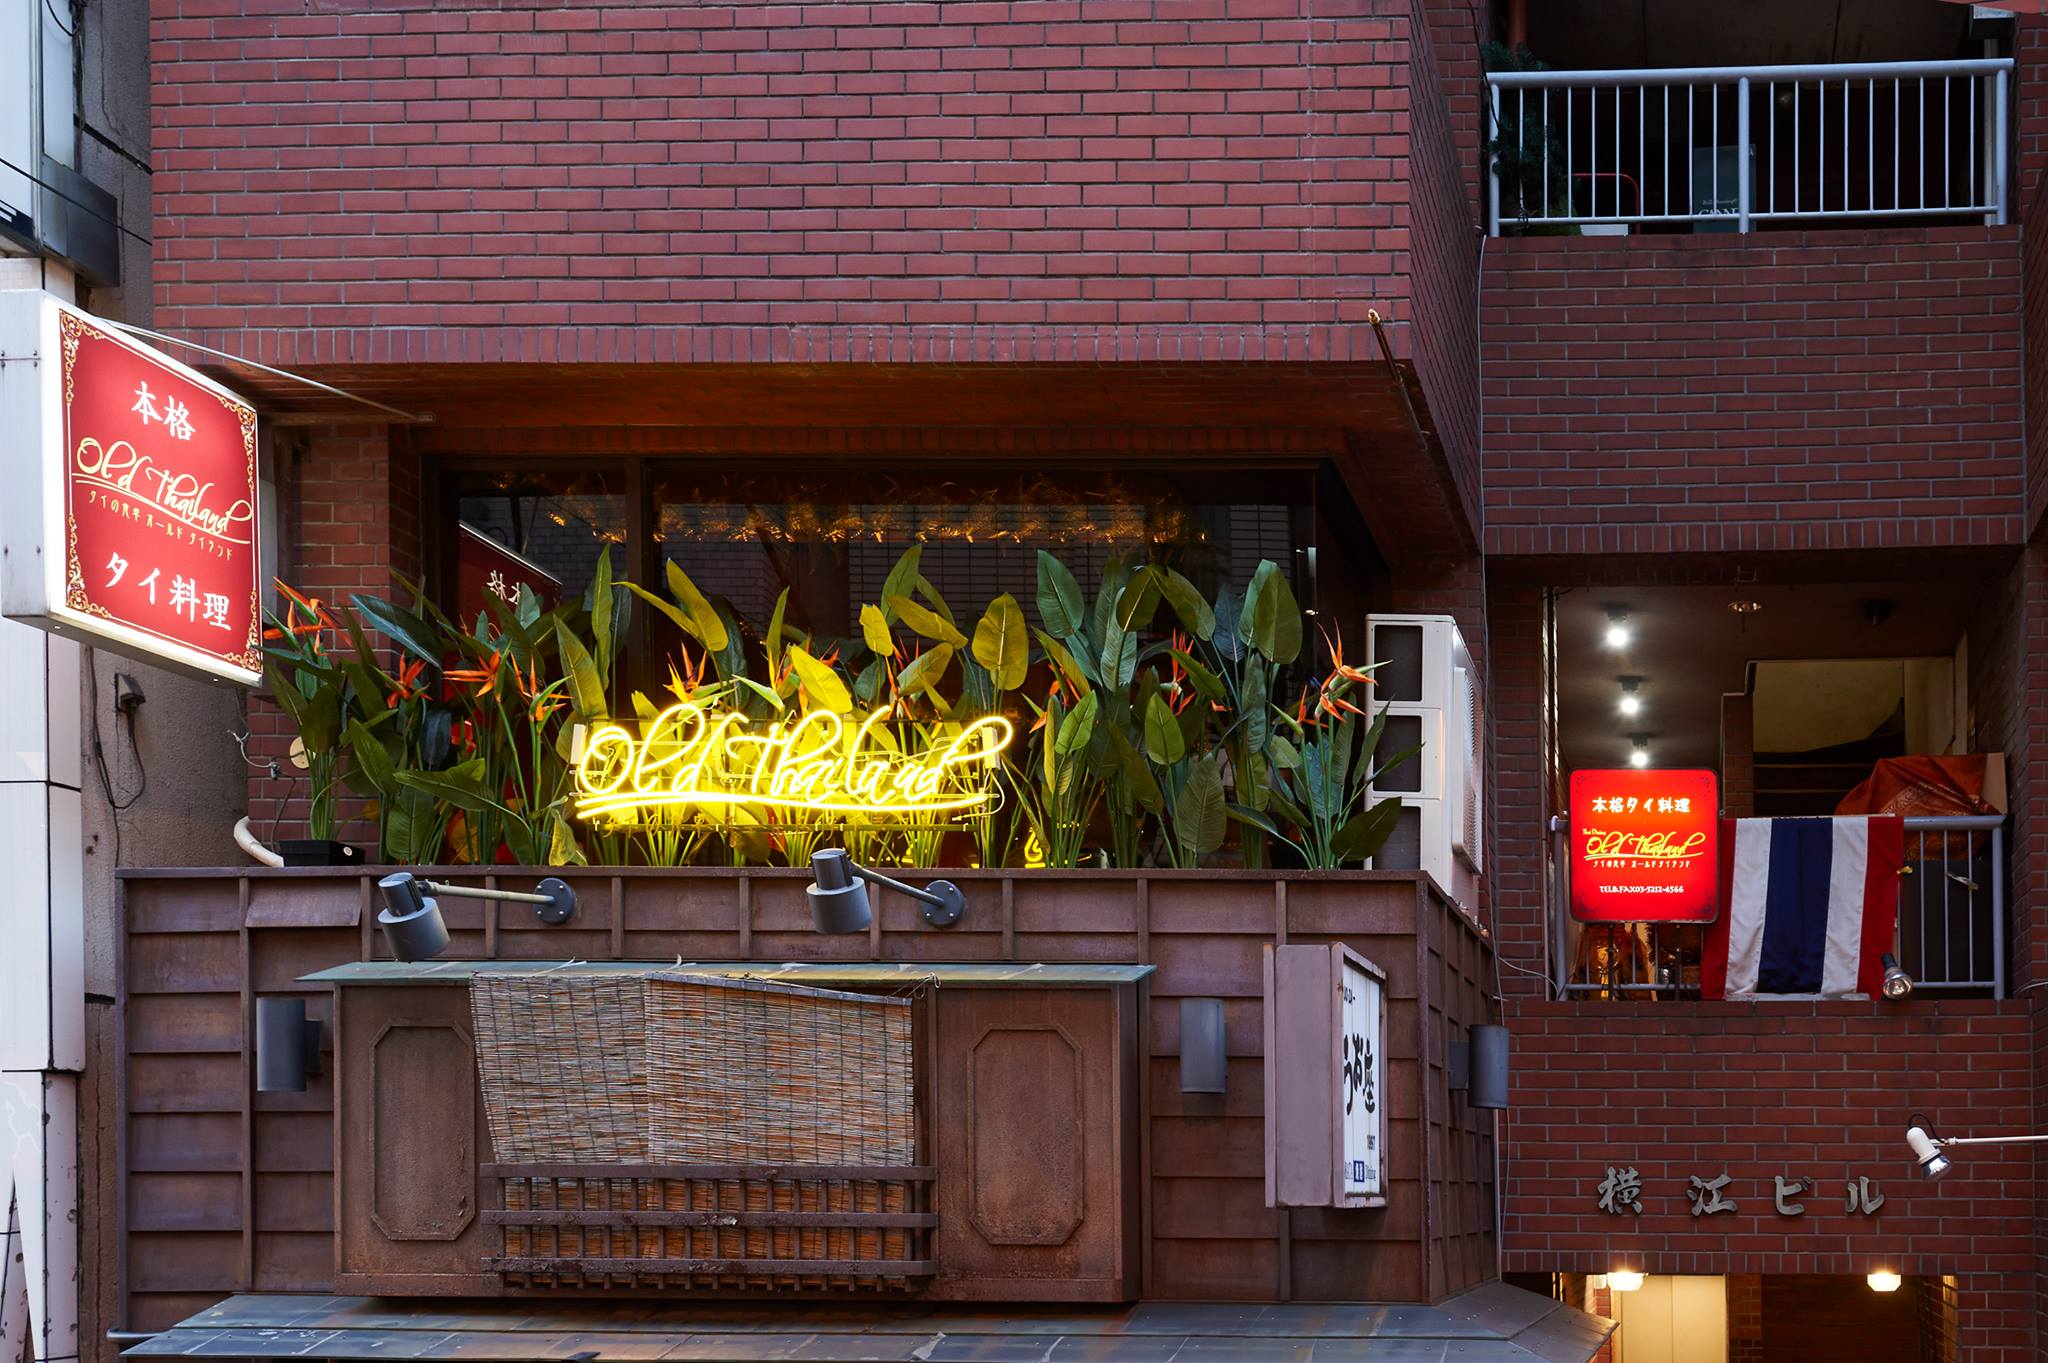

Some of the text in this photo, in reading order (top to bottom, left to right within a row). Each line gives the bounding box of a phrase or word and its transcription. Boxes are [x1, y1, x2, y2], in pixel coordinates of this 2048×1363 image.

[131, 381, 196, 441] 本格
[77, 437, 253, 536] Old Thailand
[104, 551, 232, 632] タイ料理
[579, 703, 1014, 806] Old Thailand
[1592, 796, 1691, 813] 本格タイ料理
[1586, 831, 1706, 857] Old Thailand
[1597, 1165, 1885, 1217] 横江ビル
